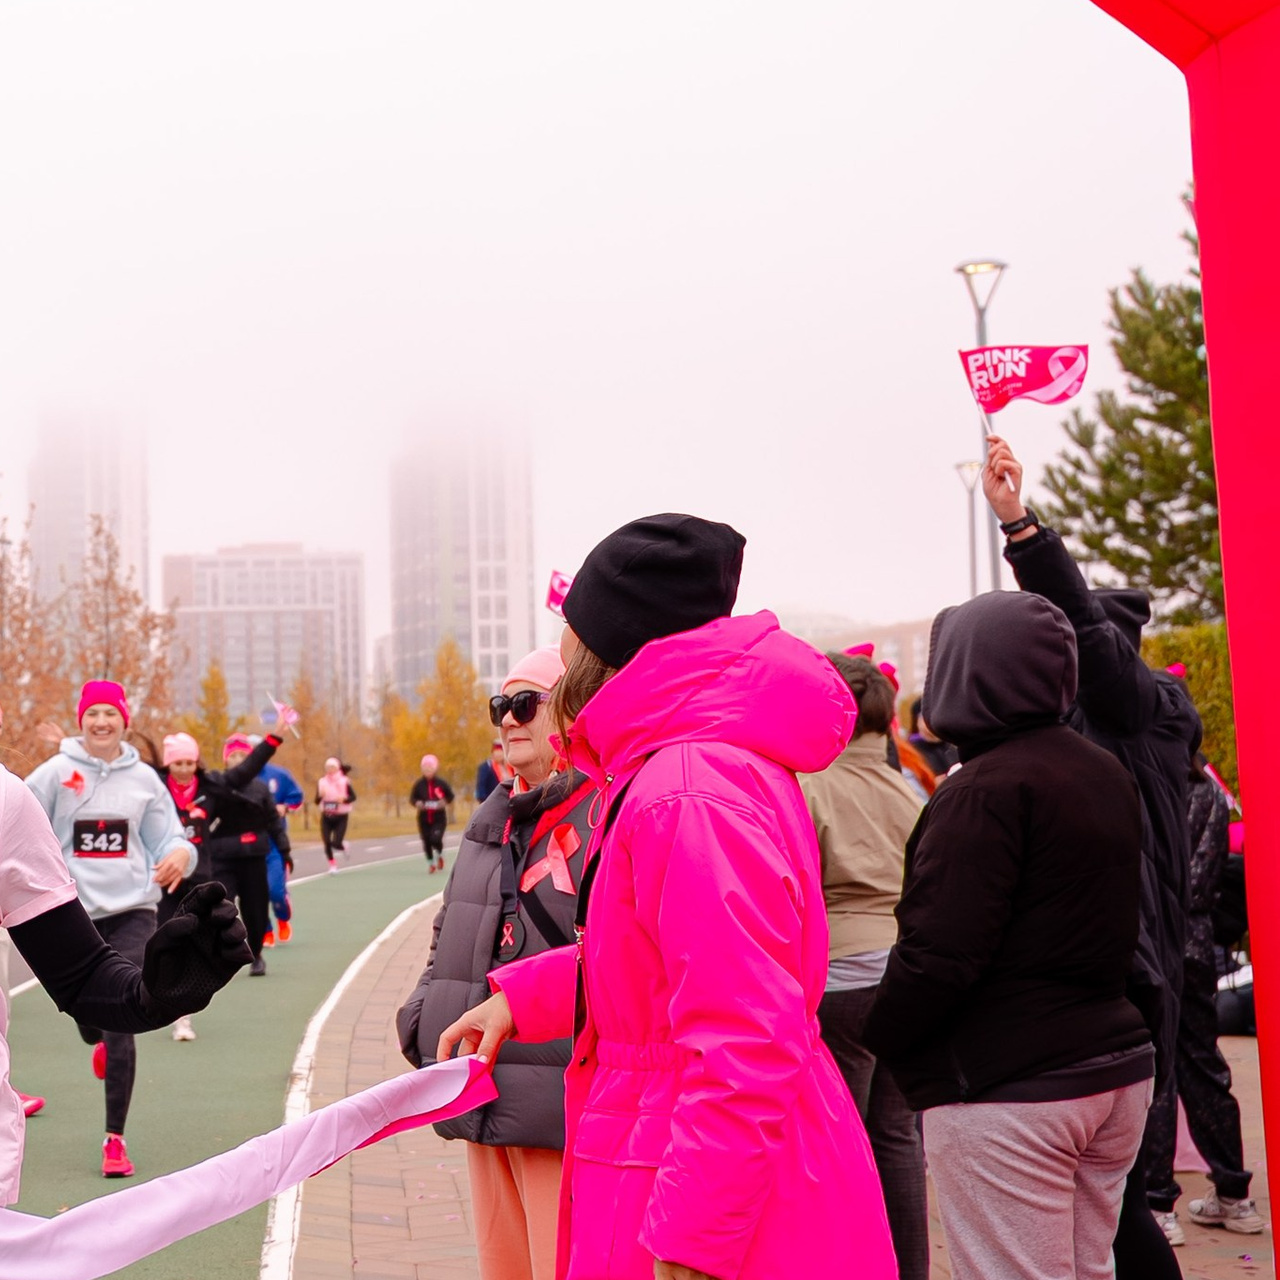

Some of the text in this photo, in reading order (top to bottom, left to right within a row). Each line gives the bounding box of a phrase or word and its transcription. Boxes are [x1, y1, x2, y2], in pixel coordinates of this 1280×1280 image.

[967, 348, 1032, 372] PINK
[970, 361, 1026, 390] RUN
[81, 833, 122, 851] 342
